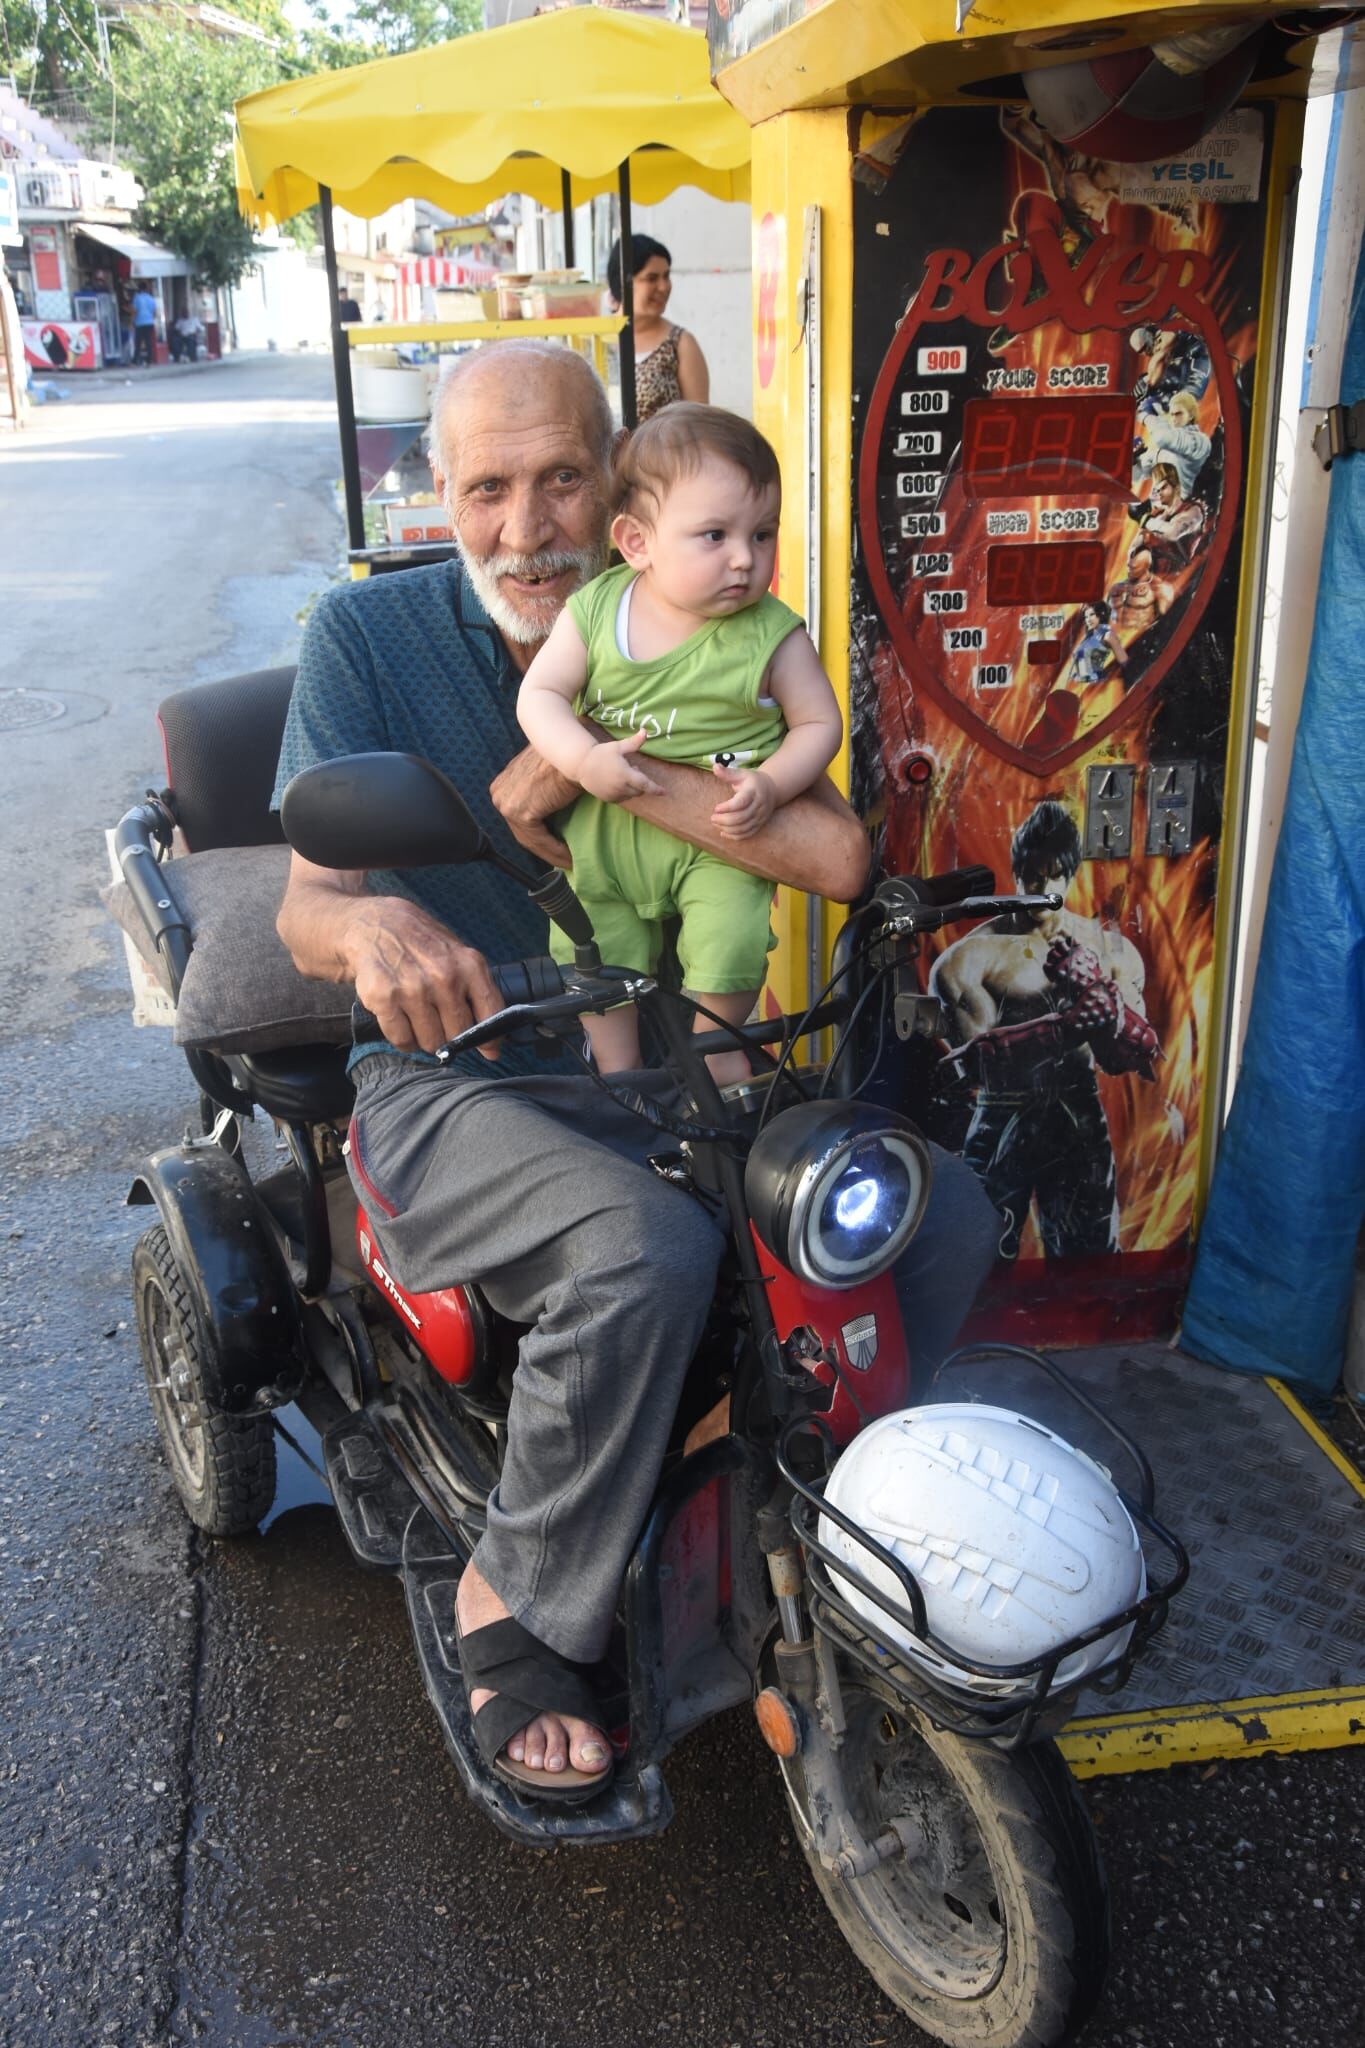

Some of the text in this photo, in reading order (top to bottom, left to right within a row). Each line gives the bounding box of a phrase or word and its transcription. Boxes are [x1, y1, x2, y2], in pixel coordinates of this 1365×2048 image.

[1152, 159, 1234, 184] YEŞİL
[923, 233, 1212, 335] BOXER
[927, 351, 961, 371] 900
[987, 365, 1108, 391] YOUR SCORE
[909, 393, 943, 412] 800
[904, 434, 935, 454] 700
[902, 475, 935, 493] 600
[907, 516, 940, 534] 500
[988, 510, 1098, 534] HIGH SCORE
[915, 555, 949, 575] 400
[930, 593, 963, 611] 300
[950, 631, 982, 648] 200
[980, 666, 1007, 684] 100
